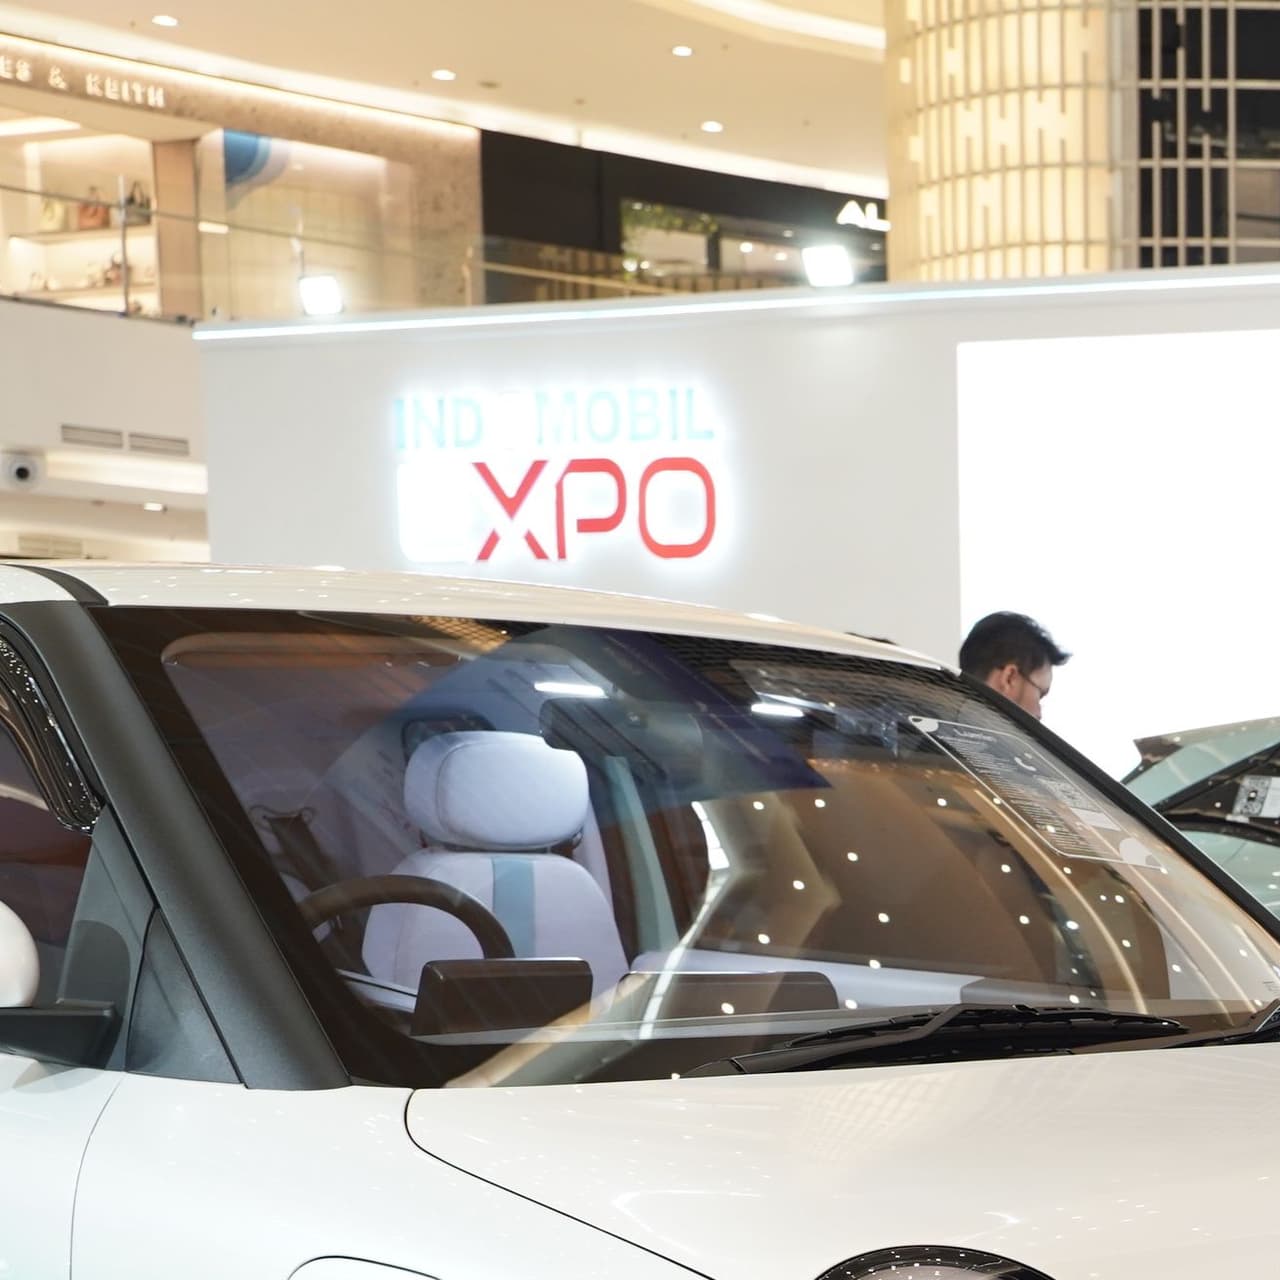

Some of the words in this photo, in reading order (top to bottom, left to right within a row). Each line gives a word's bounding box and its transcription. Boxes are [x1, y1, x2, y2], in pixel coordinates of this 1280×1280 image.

[48, 65, 67, 90] &
[86, 72, 166, 108] KEITH
[393, 386, 716, 452] INDMOBIL
[397, 456, 717, 562] XPO
